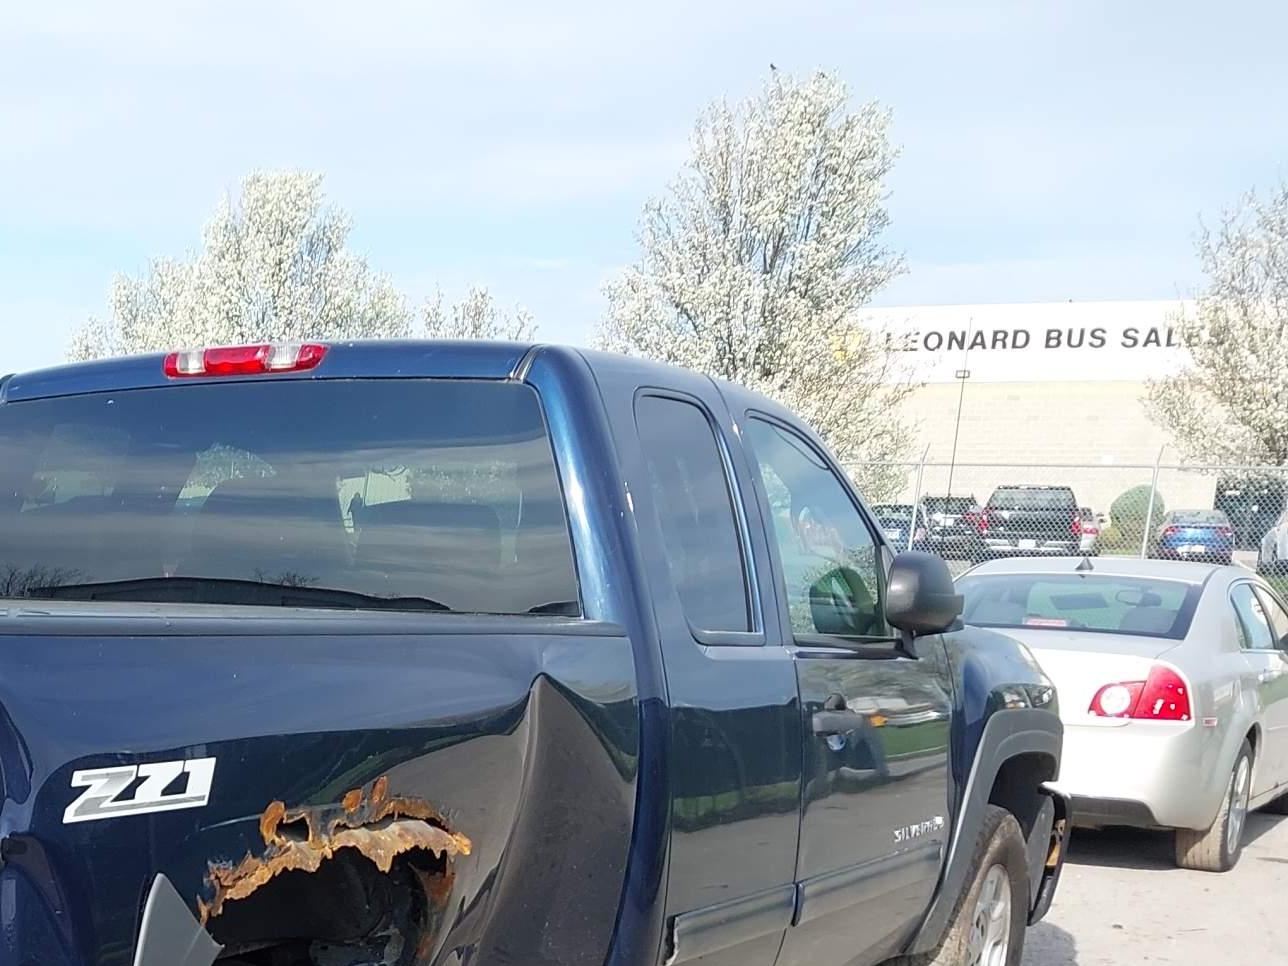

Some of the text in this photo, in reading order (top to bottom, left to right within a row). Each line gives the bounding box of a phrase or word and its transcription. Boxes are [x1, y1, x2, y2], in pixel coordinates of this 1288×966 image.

[885, 326, 1204, 351] LEONARD BUS SALE
[62, 757, 216, 824] Z71
[893, 816, 945, 843] SILVERO
